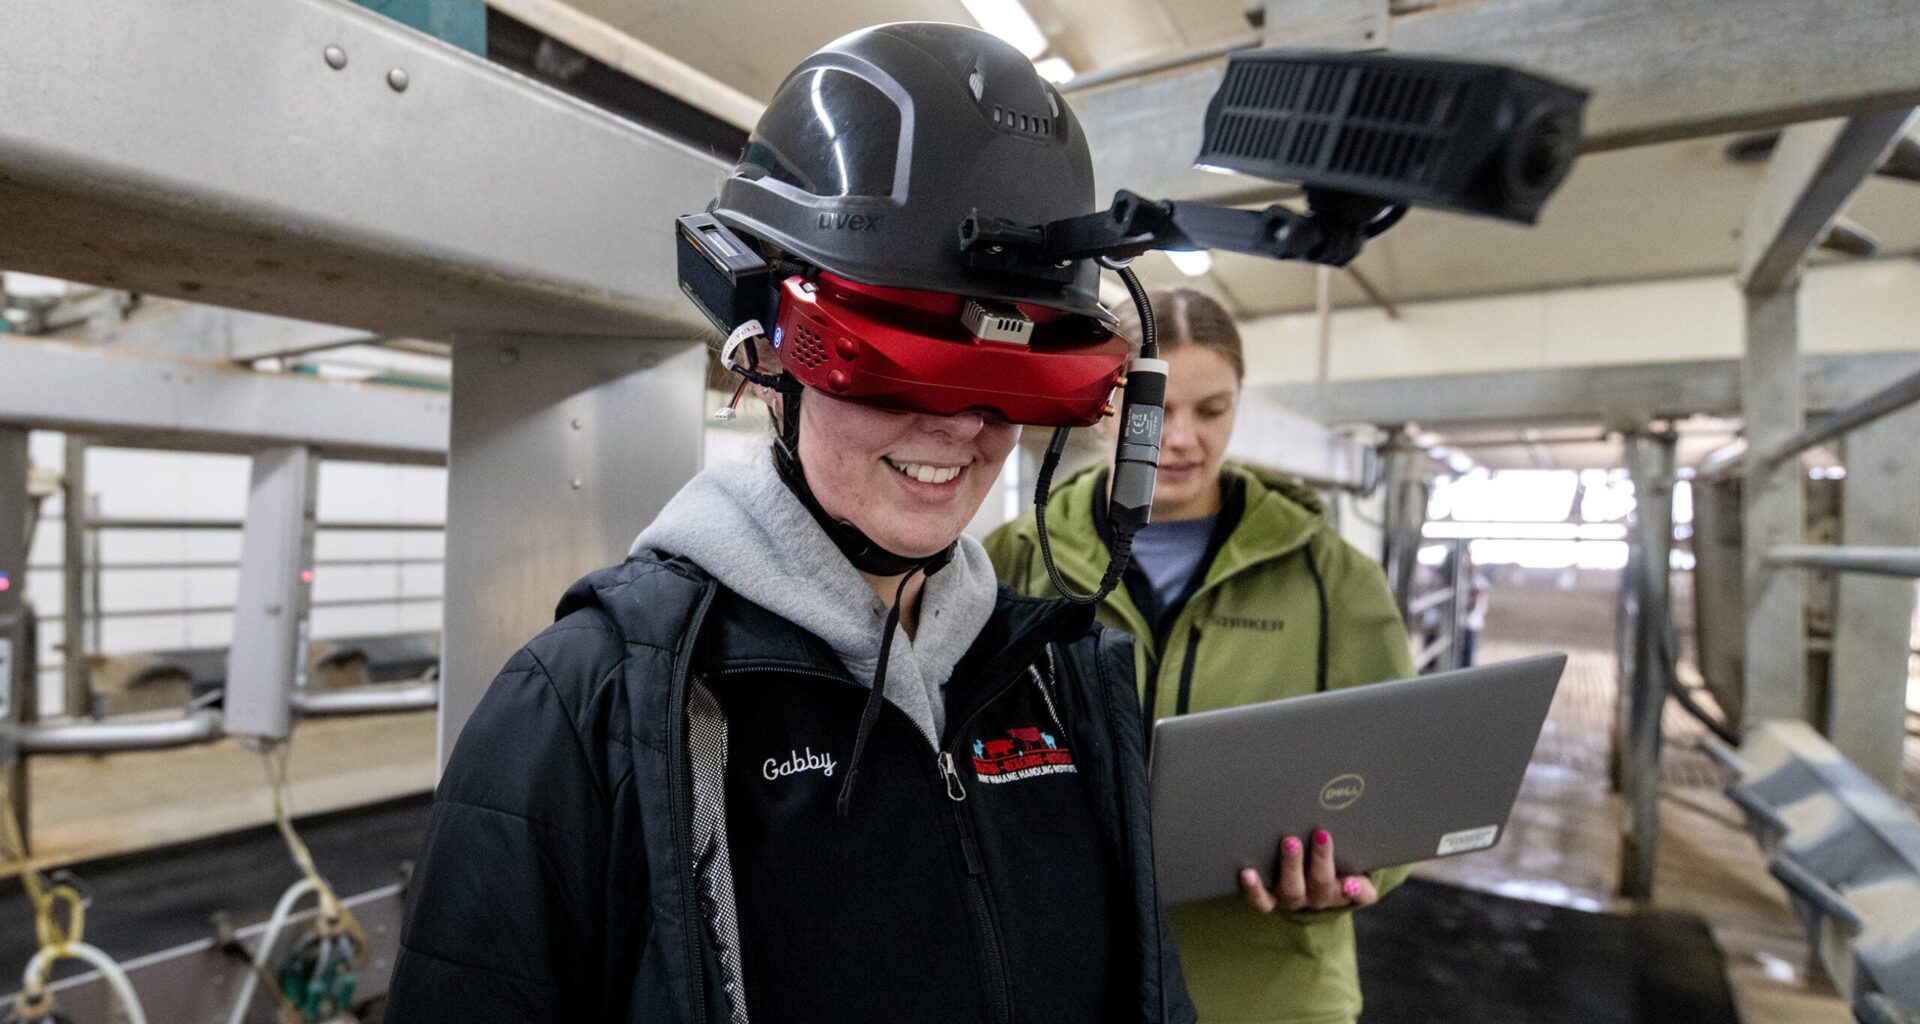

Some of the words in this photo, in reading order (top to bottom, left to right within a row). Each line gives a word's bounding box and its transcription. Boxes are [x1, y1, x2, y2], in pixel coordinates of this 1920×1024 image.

[817, 213, 878, 231] uvex
[763, 746, 837, 780] Gabby
[1325, 785, 1358, 799] DELL
